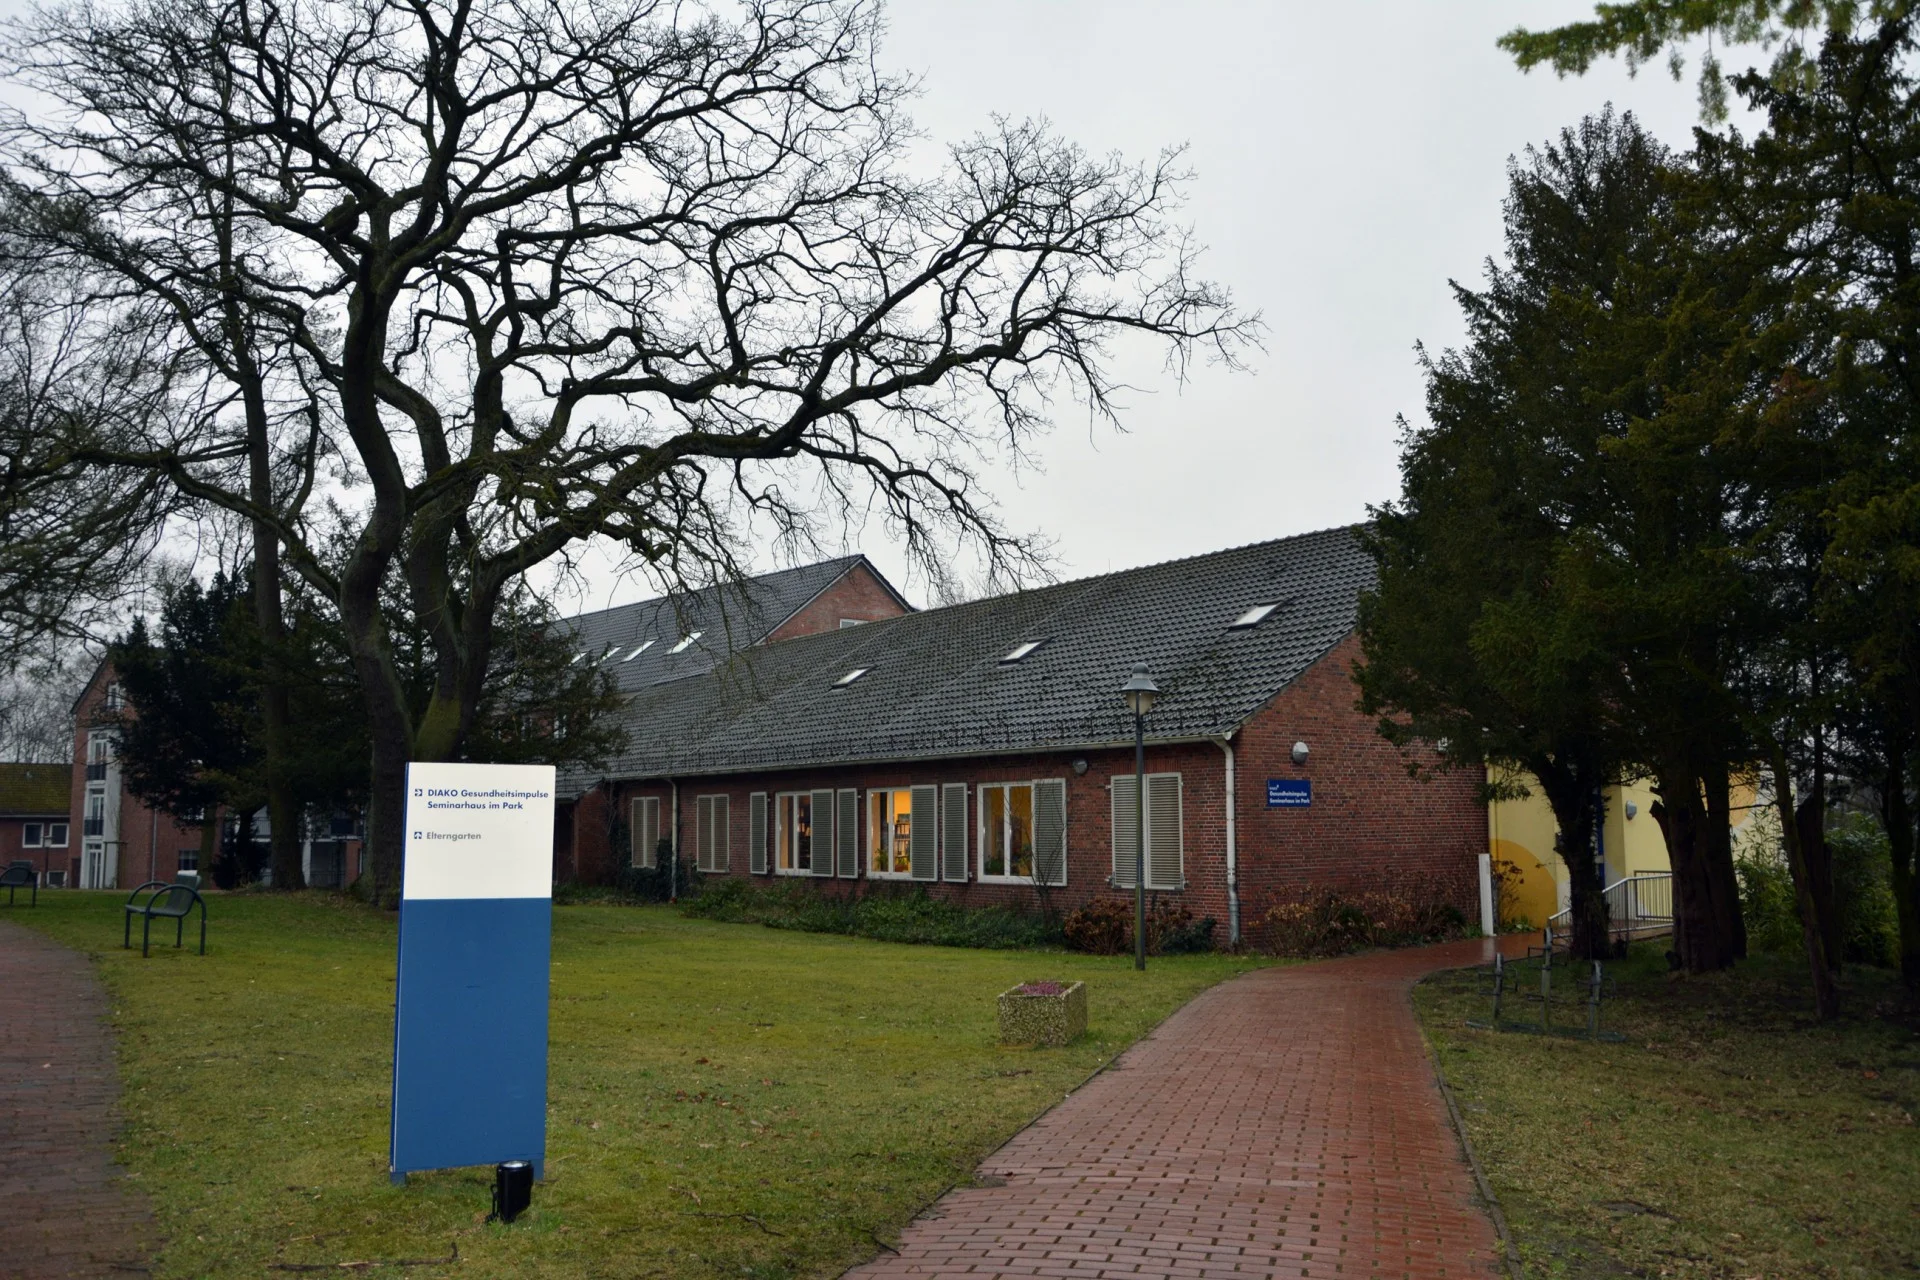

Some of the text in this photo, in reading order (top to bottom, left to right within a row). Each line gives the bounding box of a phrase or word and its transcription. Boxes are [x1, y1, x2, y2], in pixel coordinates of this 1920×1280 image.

[427, 789, 549, 800] DIAKO Gesundheitsimpulse
[427, 801, 524, 810] Seminarhaus im Park
[426, 831, 481, 841] Elterngarten
